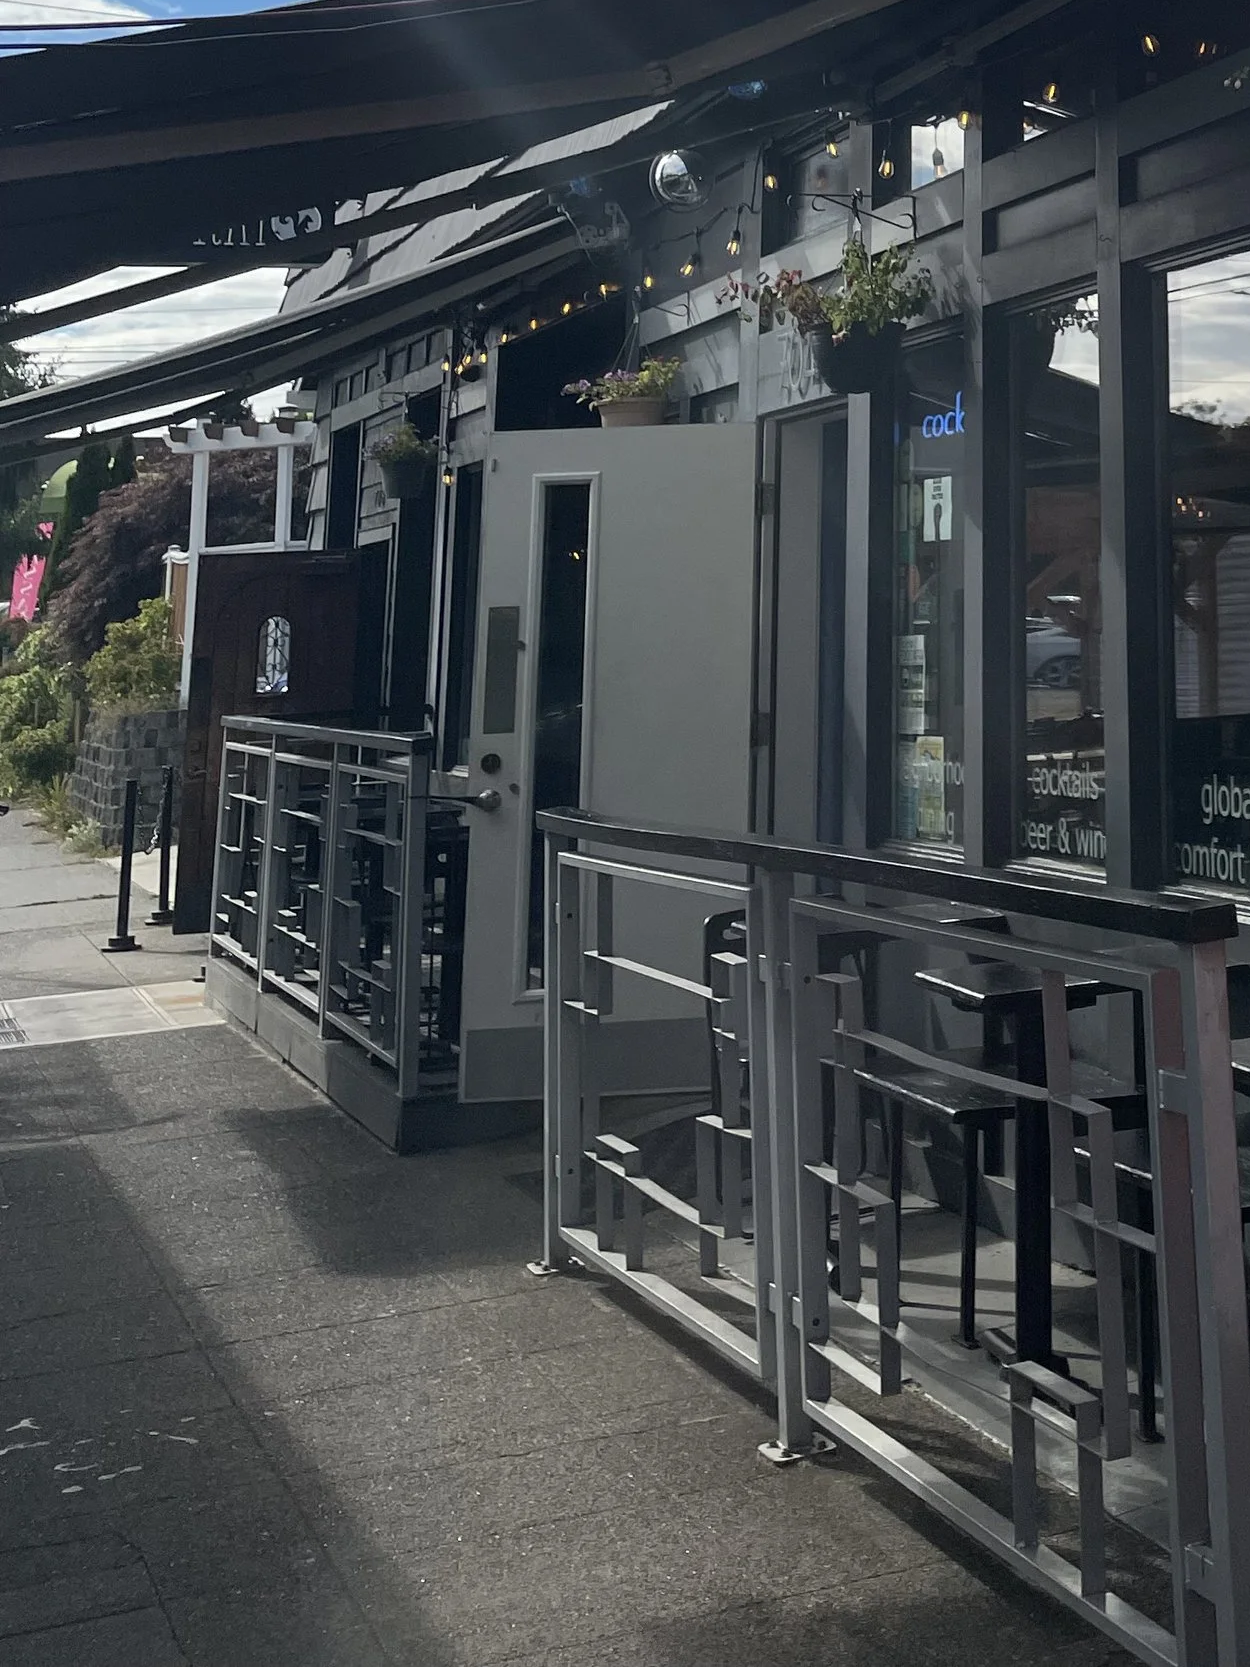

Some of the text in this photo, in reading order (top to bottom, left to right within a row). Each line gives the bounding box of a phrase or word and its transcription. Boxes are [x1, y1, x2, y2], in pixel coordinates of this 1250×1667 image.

[922, 391, 965, 438] cock
[1031, 761, 1099, 800] cocktails
[1057, 816, 1072, 855] &
[1075, 822, 1107, 859] win
[1175, 837, 1246, 884] omfort
